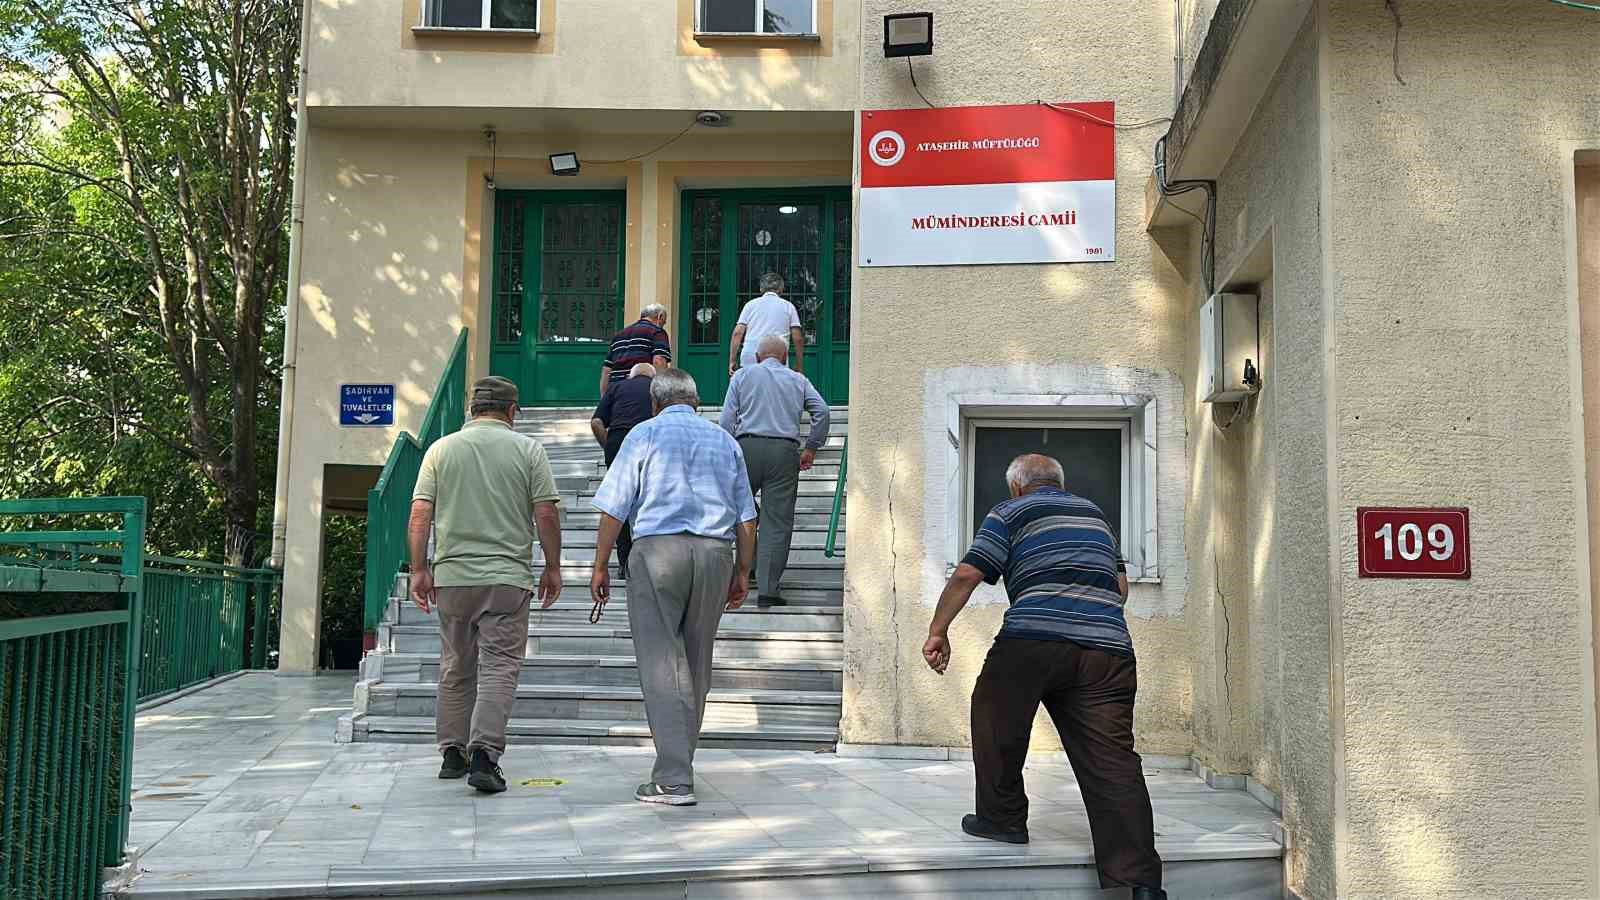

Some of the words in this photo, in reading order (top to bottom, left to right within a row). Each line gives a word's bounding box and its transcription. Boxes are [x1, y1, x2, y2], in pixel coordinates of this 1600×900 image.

[916, 138, 969, 152] ATAŞEHİR
[972, 137, 1040, 150] MÜFTÜLÜĞÜ
[911, 212, 1025, 230] MÜMİNDERESİ
[1028, 210, 1077, 226] CAMİİ
[1085, 247, 1103, 255] 1981
[343, 404, 392, 412] TUVALETLER
[1374, 522, 1455, 561] 109
